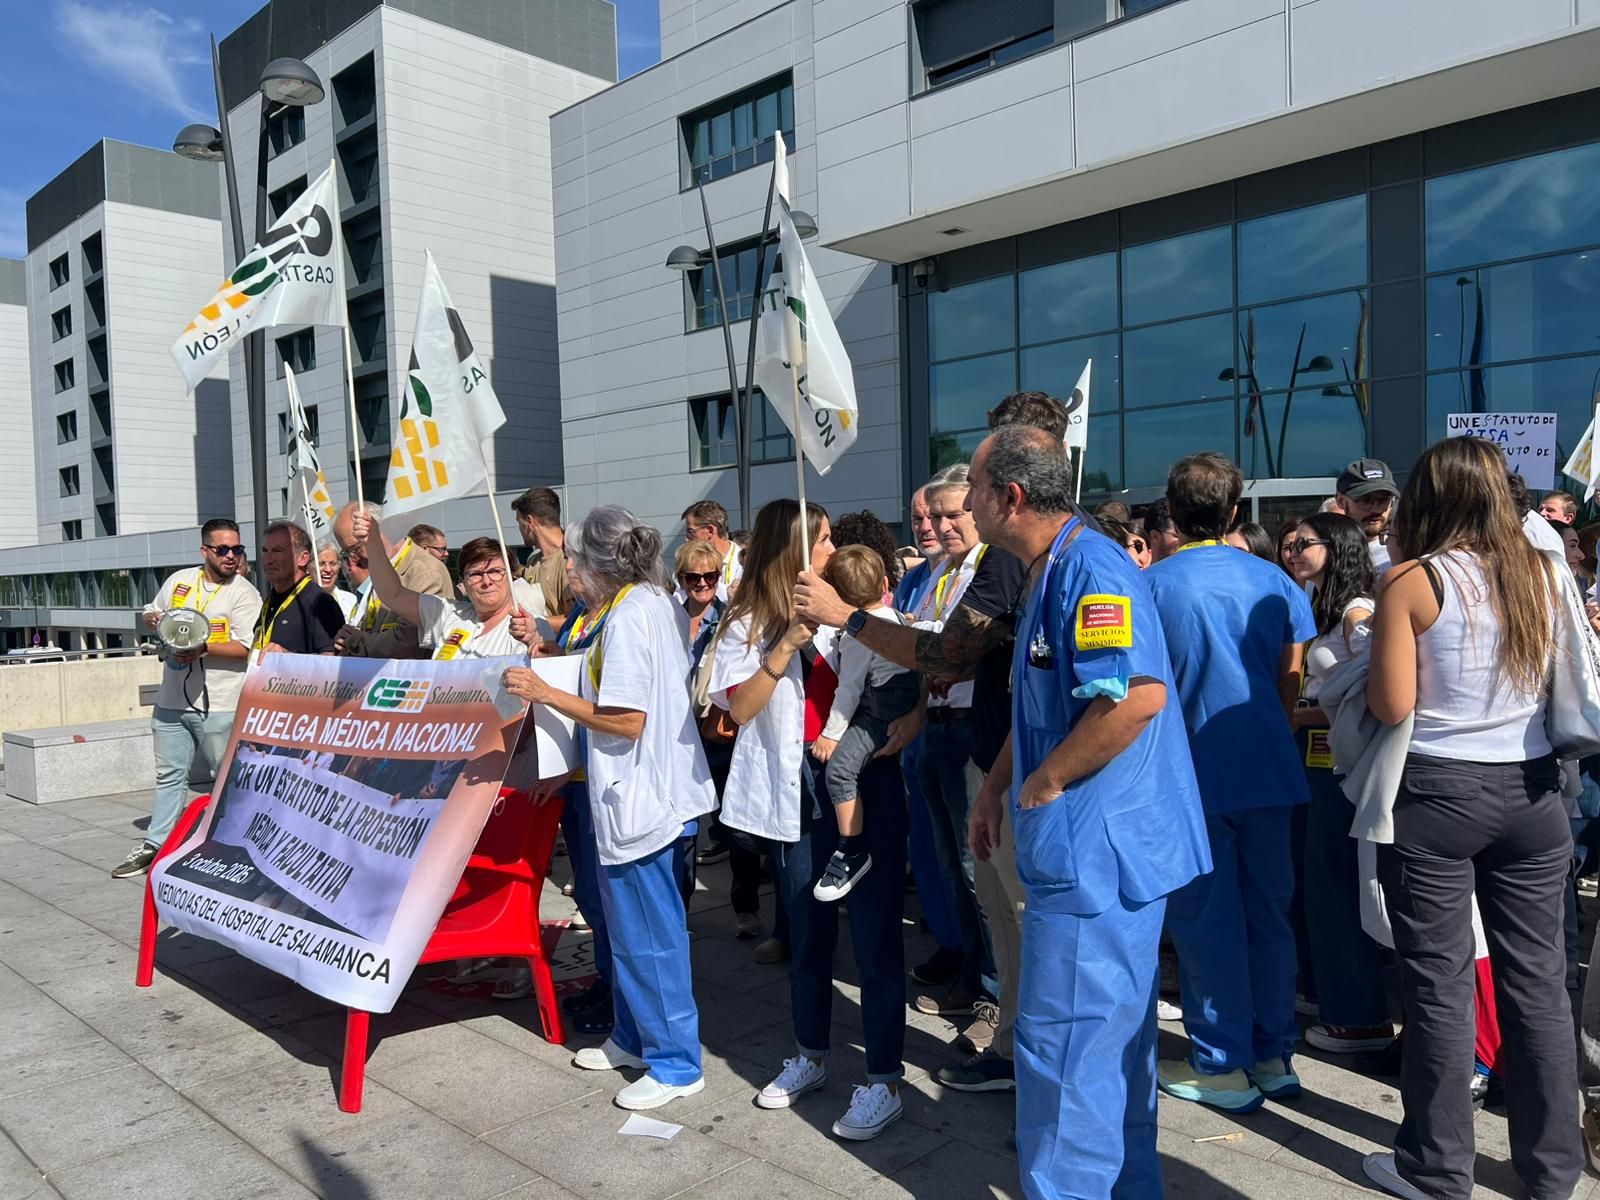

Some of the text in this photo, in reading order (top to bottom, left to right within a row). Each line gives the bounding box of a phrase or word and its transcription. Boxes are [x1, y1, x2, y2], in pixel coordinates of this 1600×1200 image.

[1449, 414, 1555, 429] UN ESTATUTO DE
[1536, 448, 1550, 456] DE
[1081, 629, 1125, 638] SERVICIOS
[262, 677, 318, 698] Sindicato
[242, 707, 484, 753] HUELGA MÉDICA NACIONAL
[235, 763, 431, 859] OR UN ESTATUTO DE LA PROFESIÓN
[243, 808, 354, 904] MÉDICA Y FACULTATIVA
[190, 857, 228, 877] octubre
[220, 862, 254, 884] 2025
[198, 897, 222, 922] DEL
[217, 904, 273, 941] HOSPITAL
[268, 923, 295, 947] DE
[286, 929, 391, 985] SALAMANCA
